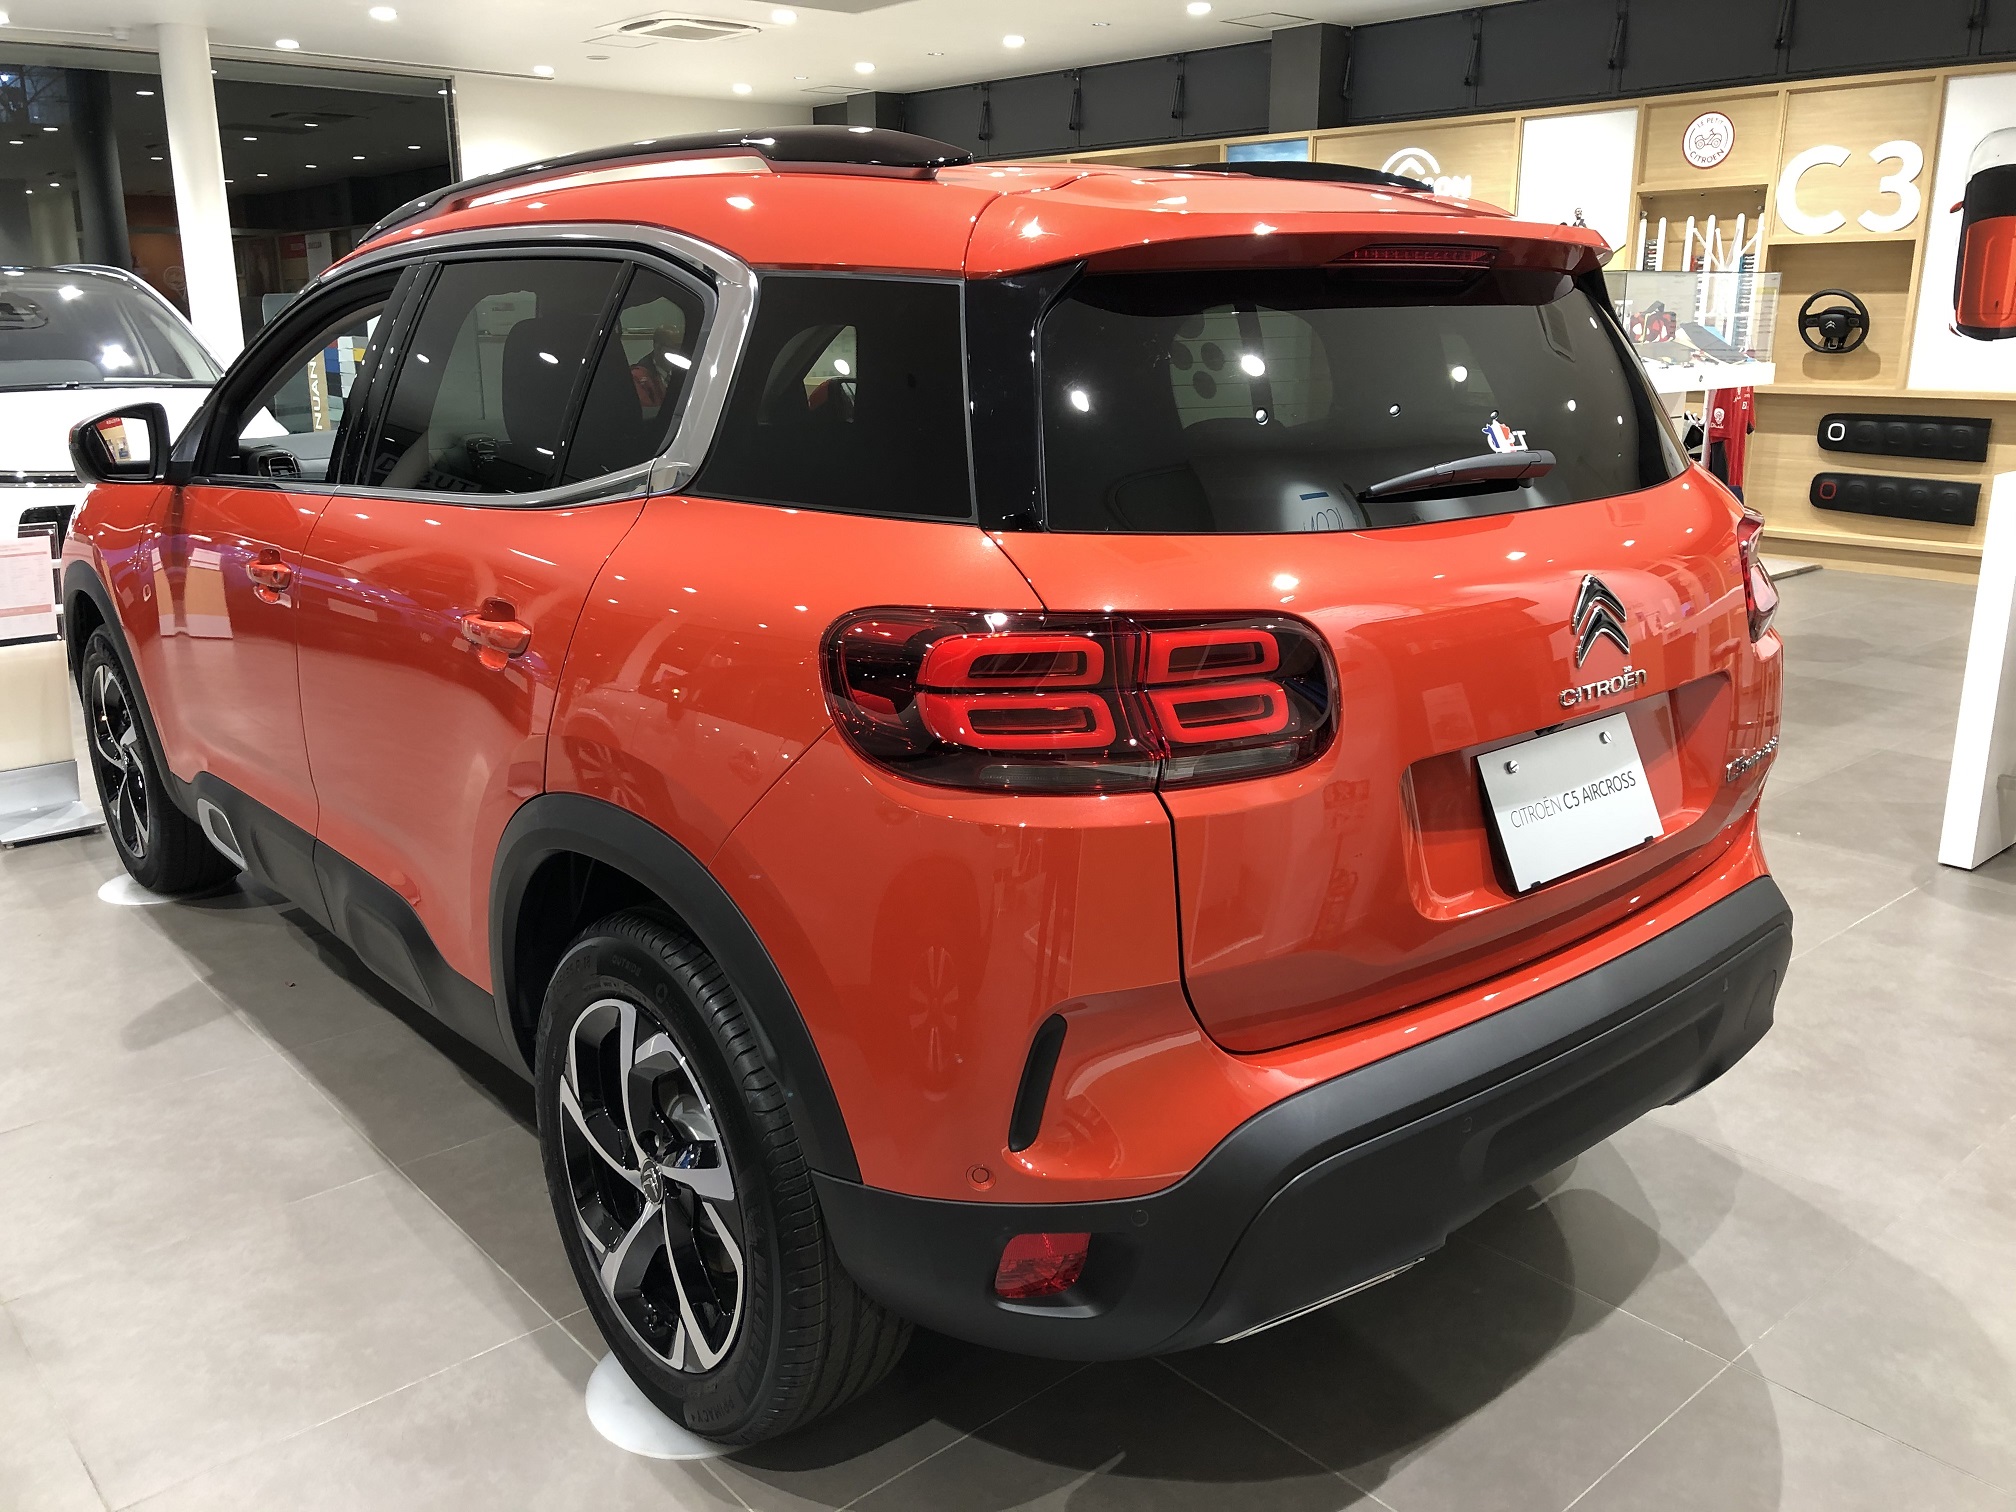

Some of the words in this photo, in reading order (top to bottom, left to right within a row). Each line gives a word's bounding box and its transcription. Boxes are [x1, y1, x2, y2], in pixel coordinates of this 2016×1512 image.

[1776, 140, 1924, 236] C3
[309, 357, 323, 430] NUAN
[1510, 796, 1563, 828] CITROËN
[1563, 790, 1580, 809] C5
[1582, 770, 1636, 804] AIRCROSS
